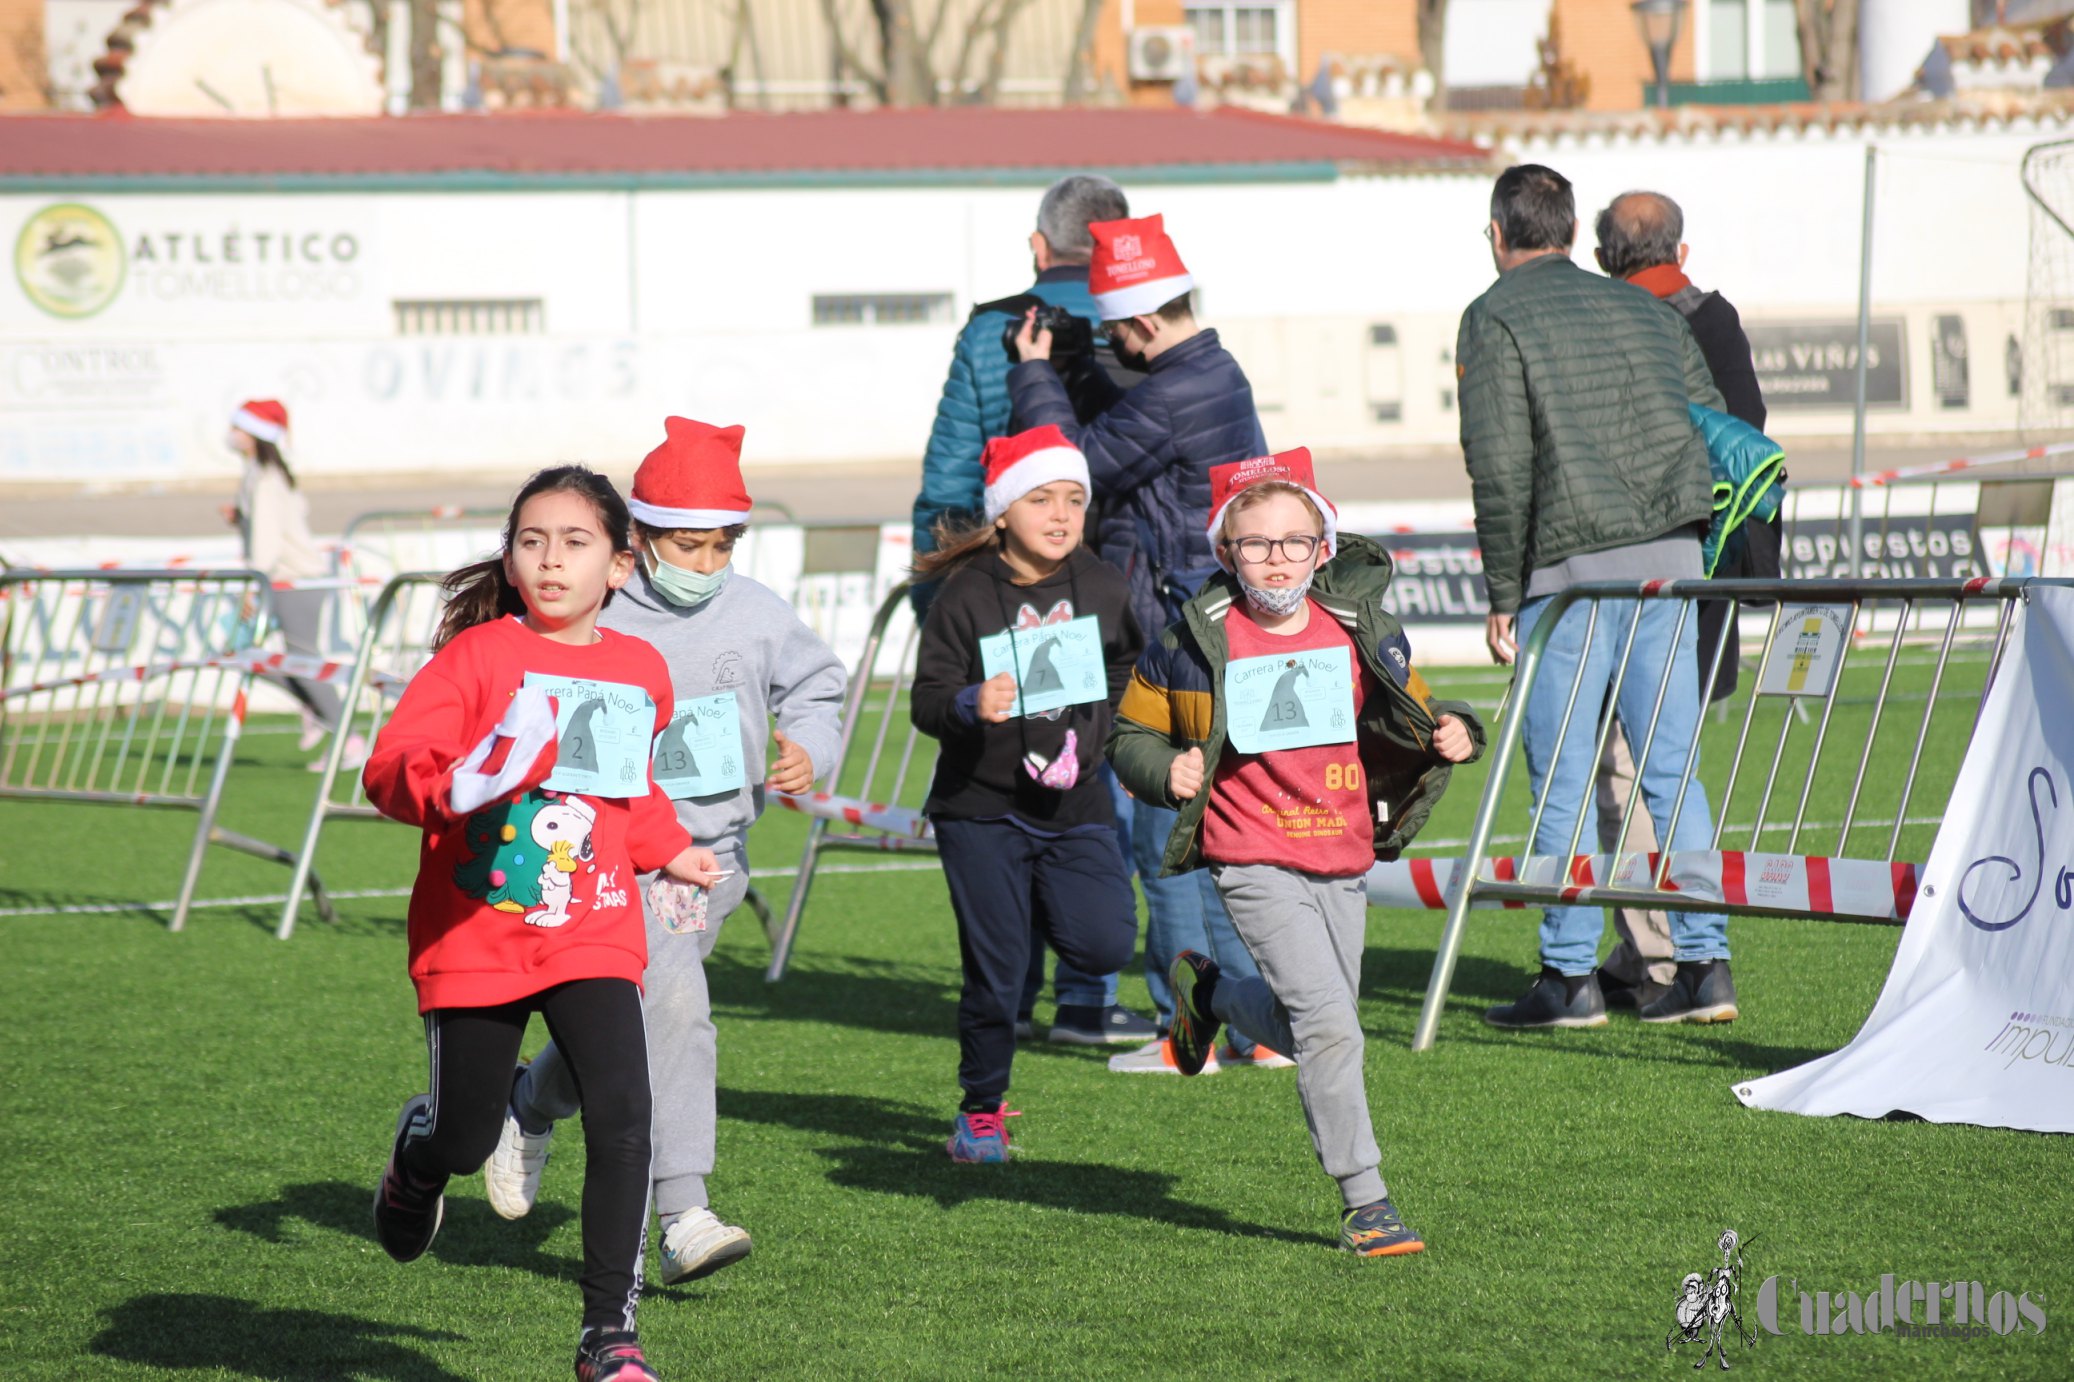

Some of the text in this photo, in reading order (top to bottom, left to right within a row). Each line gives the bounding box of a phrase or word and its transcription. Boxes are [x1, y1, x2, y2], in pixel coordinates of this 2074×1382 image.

[133, 224, 361, 263] ATLÉTICO
[1036, 669, 1046, 686] 7
[1234, 663, 1274, 685] Carrera
[576, 685, 604, 701] Papá
[1271, 700, 1297, 722] 13
[571, 735, 584, 760] 2
[659, 750, 687, 772] 13
[1325, 762, 1360, 791] 80
